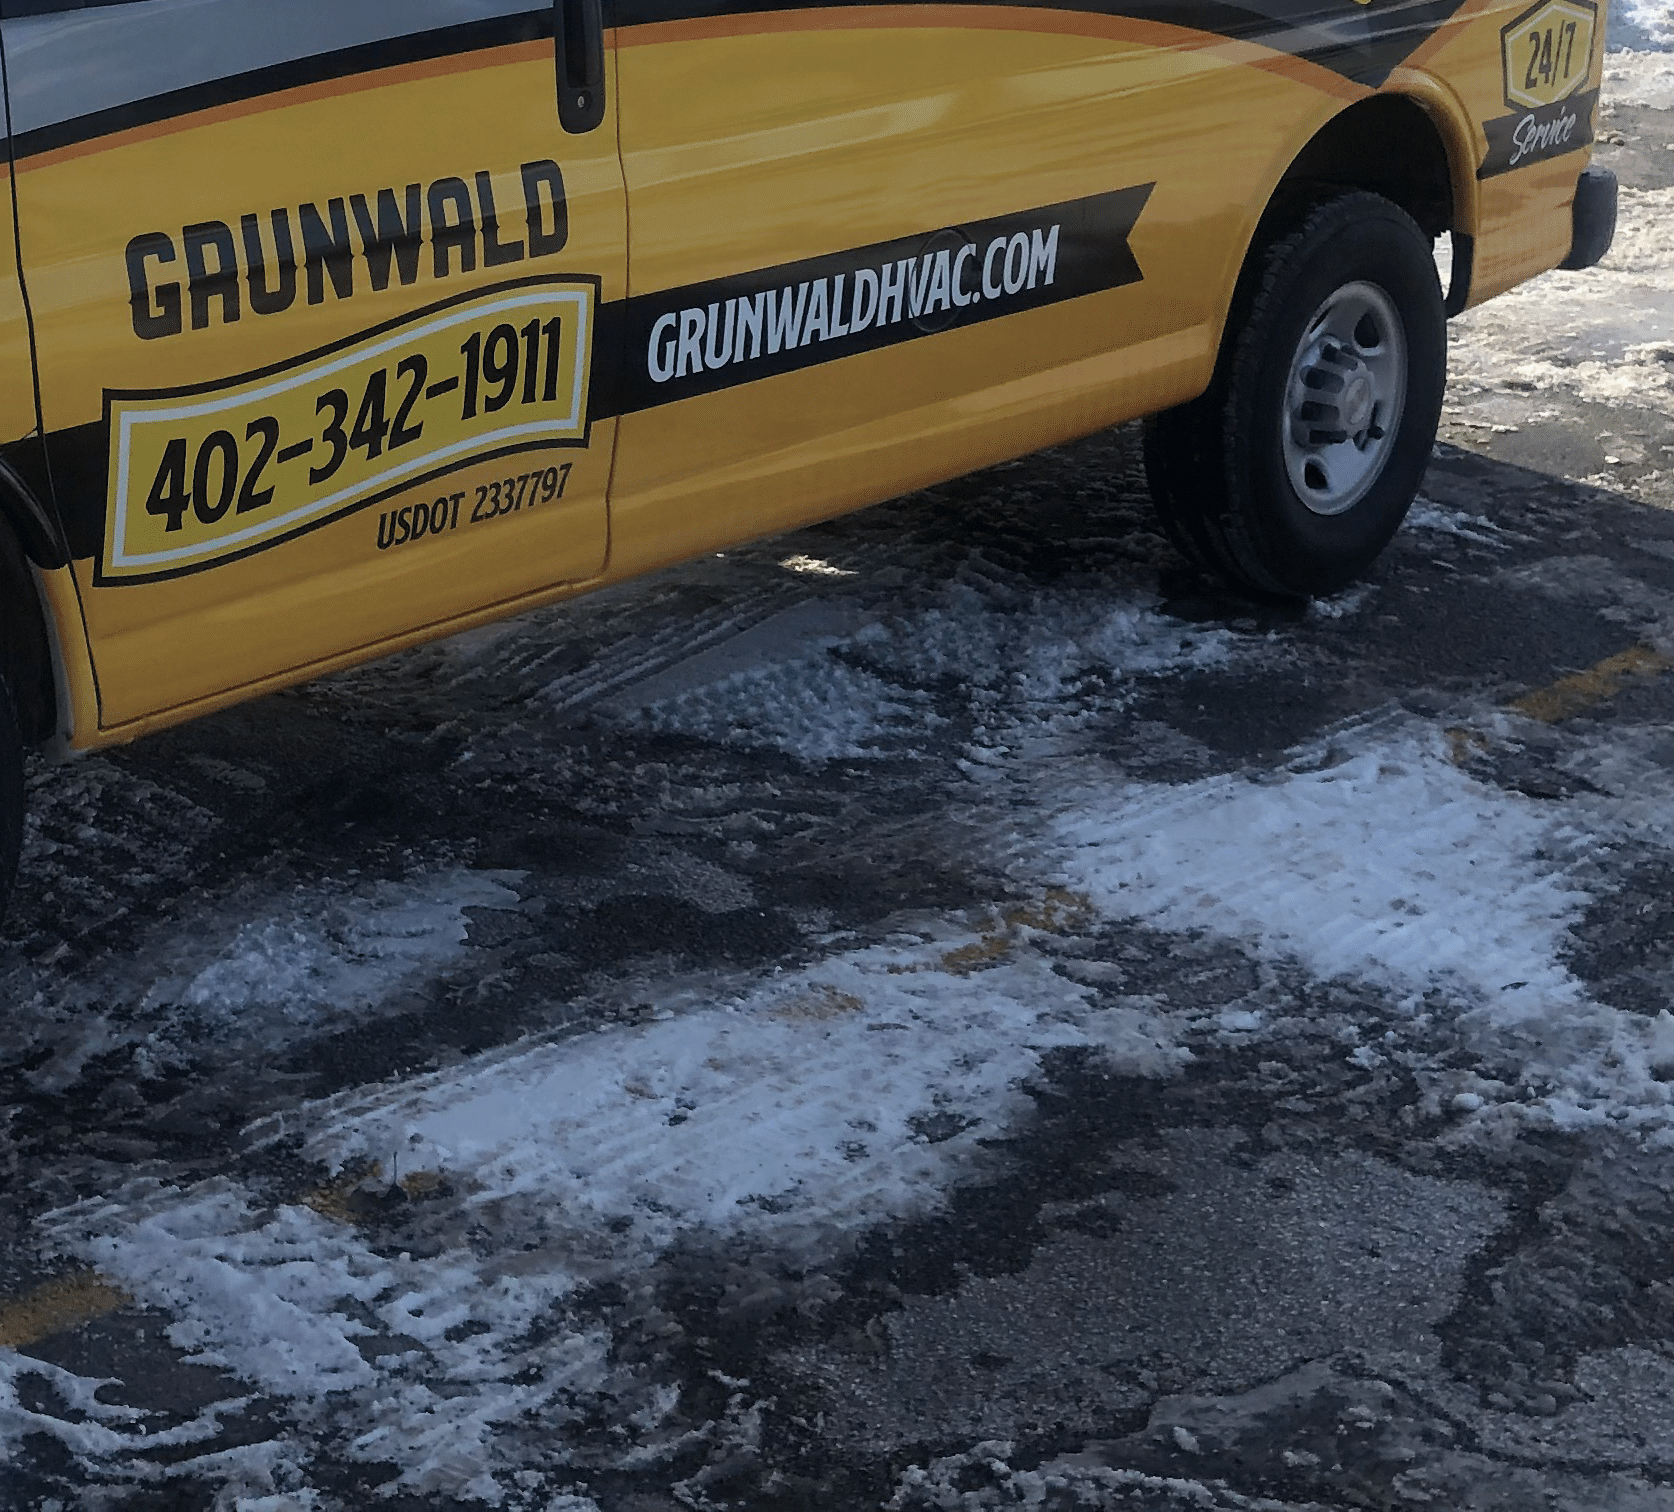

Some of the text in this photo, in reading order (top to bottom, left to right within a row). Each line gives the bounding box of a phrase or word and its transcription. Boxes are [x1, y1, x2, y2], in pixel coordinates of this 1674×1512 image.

[1525, 19, 1577, 90] 24/7
[1509, 105, 1577, 166] Service
[125, 159, 570, 341] GRUNWALD
[647, 224, 1061, 383] GRUNWALDHVAC.COM
[145, 316, 562, 533] 402-342-1911
[376, 462, 573, 550] USDOT 2337797
